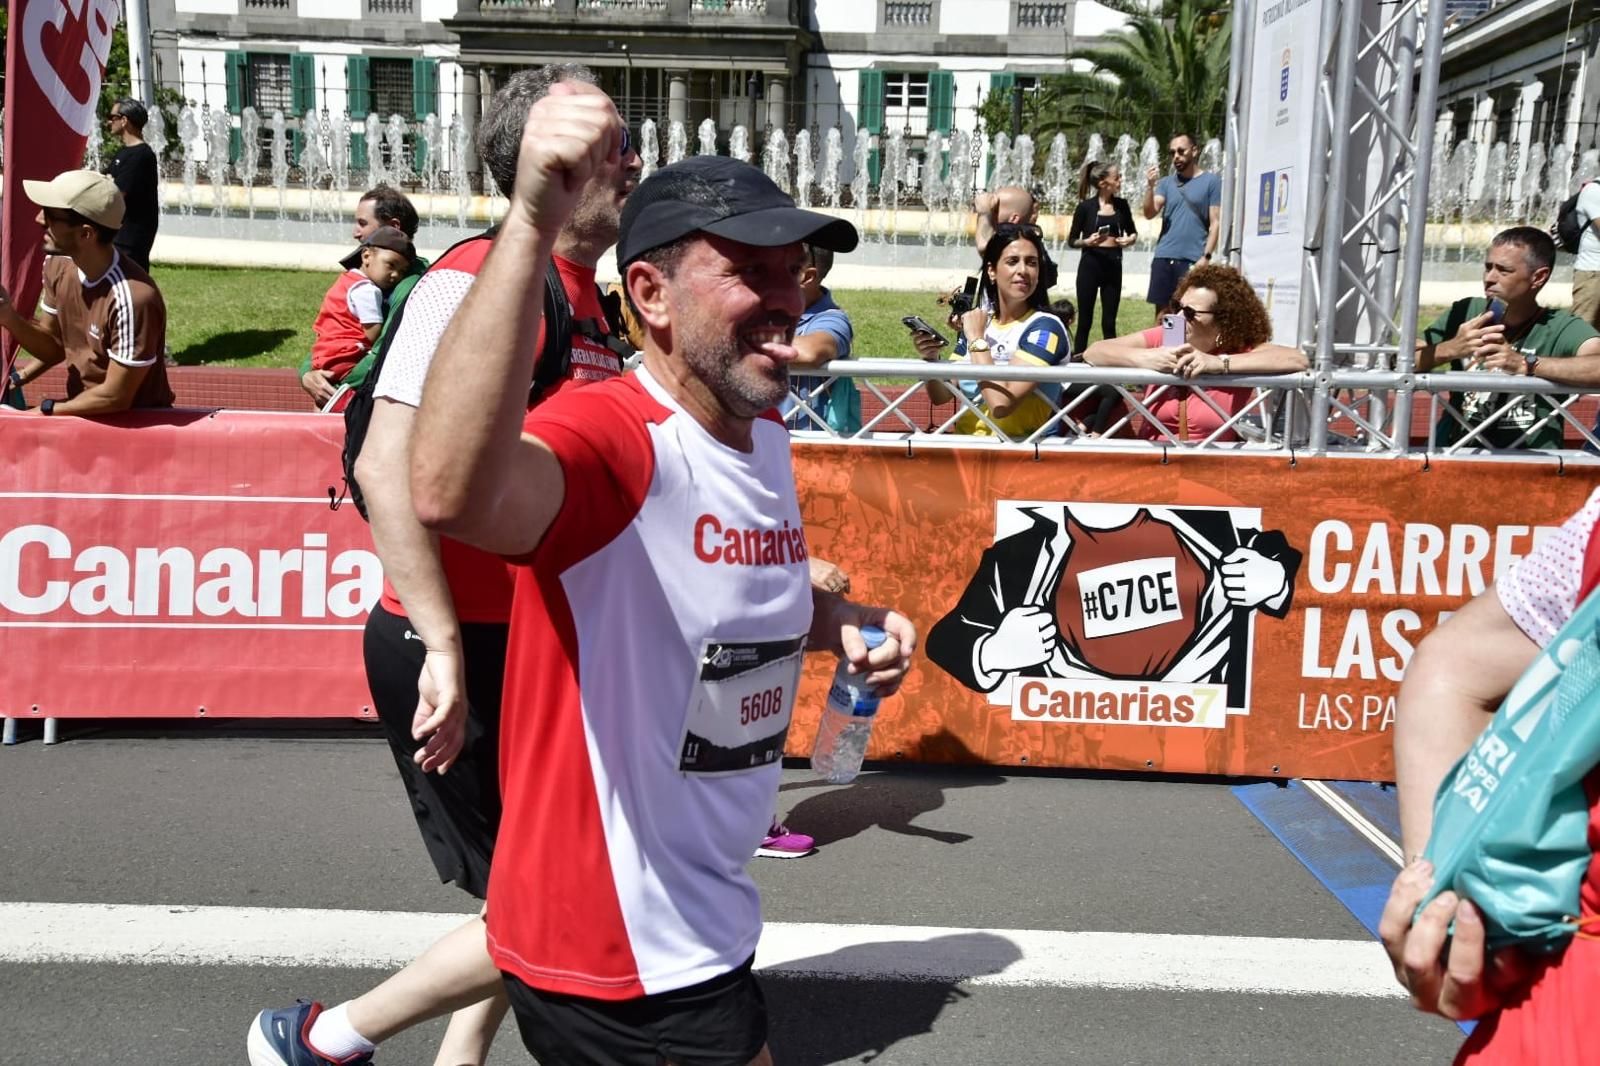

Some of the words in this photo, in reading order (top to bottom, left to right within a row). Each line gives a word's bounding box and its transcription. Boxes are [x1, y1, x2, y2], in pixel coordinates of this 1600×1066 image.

[1083, 571, 1177, 621] #C7CE
[1301, 607, 1422, 682] LAS
[740, 686, 783, 726] 5608
[1298, 693, 1353, 731] LAS
